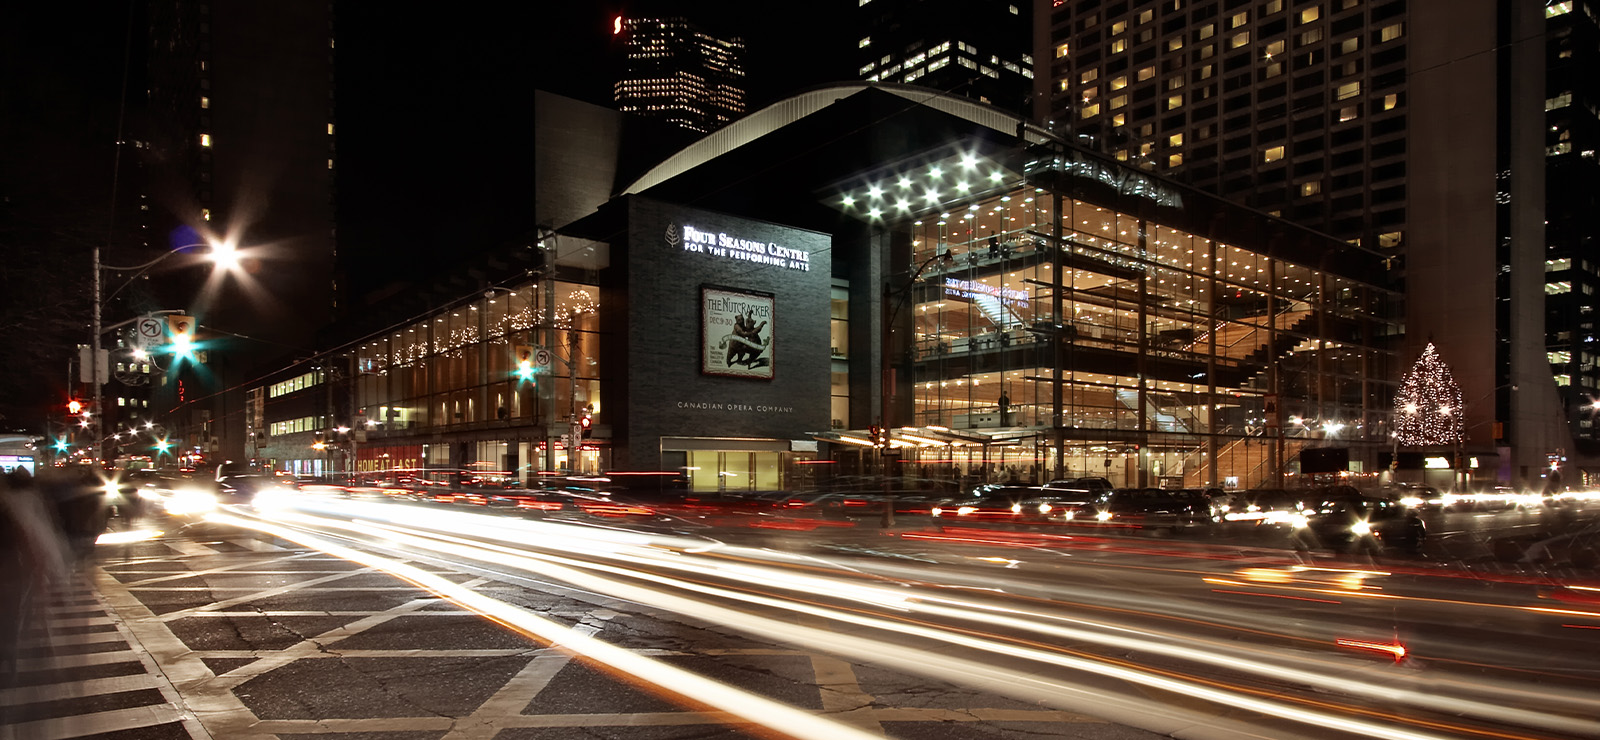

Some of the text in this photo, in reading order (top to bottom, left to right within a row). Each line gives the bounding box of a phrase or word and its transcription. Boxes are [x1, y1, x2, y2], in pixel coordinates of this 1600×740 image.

[683, 225, 810, 262] FOUR SEASONS CENTRE
[684, 241, 810, 272] FOR THE PERFORMING ARTS
[707, 296, 770, 319] THE NUTCRACKER
[677, 401, 793, 413] CANADIAN OPERA COMPANY
[357, 458, 417, 473] HOME AT LAST
